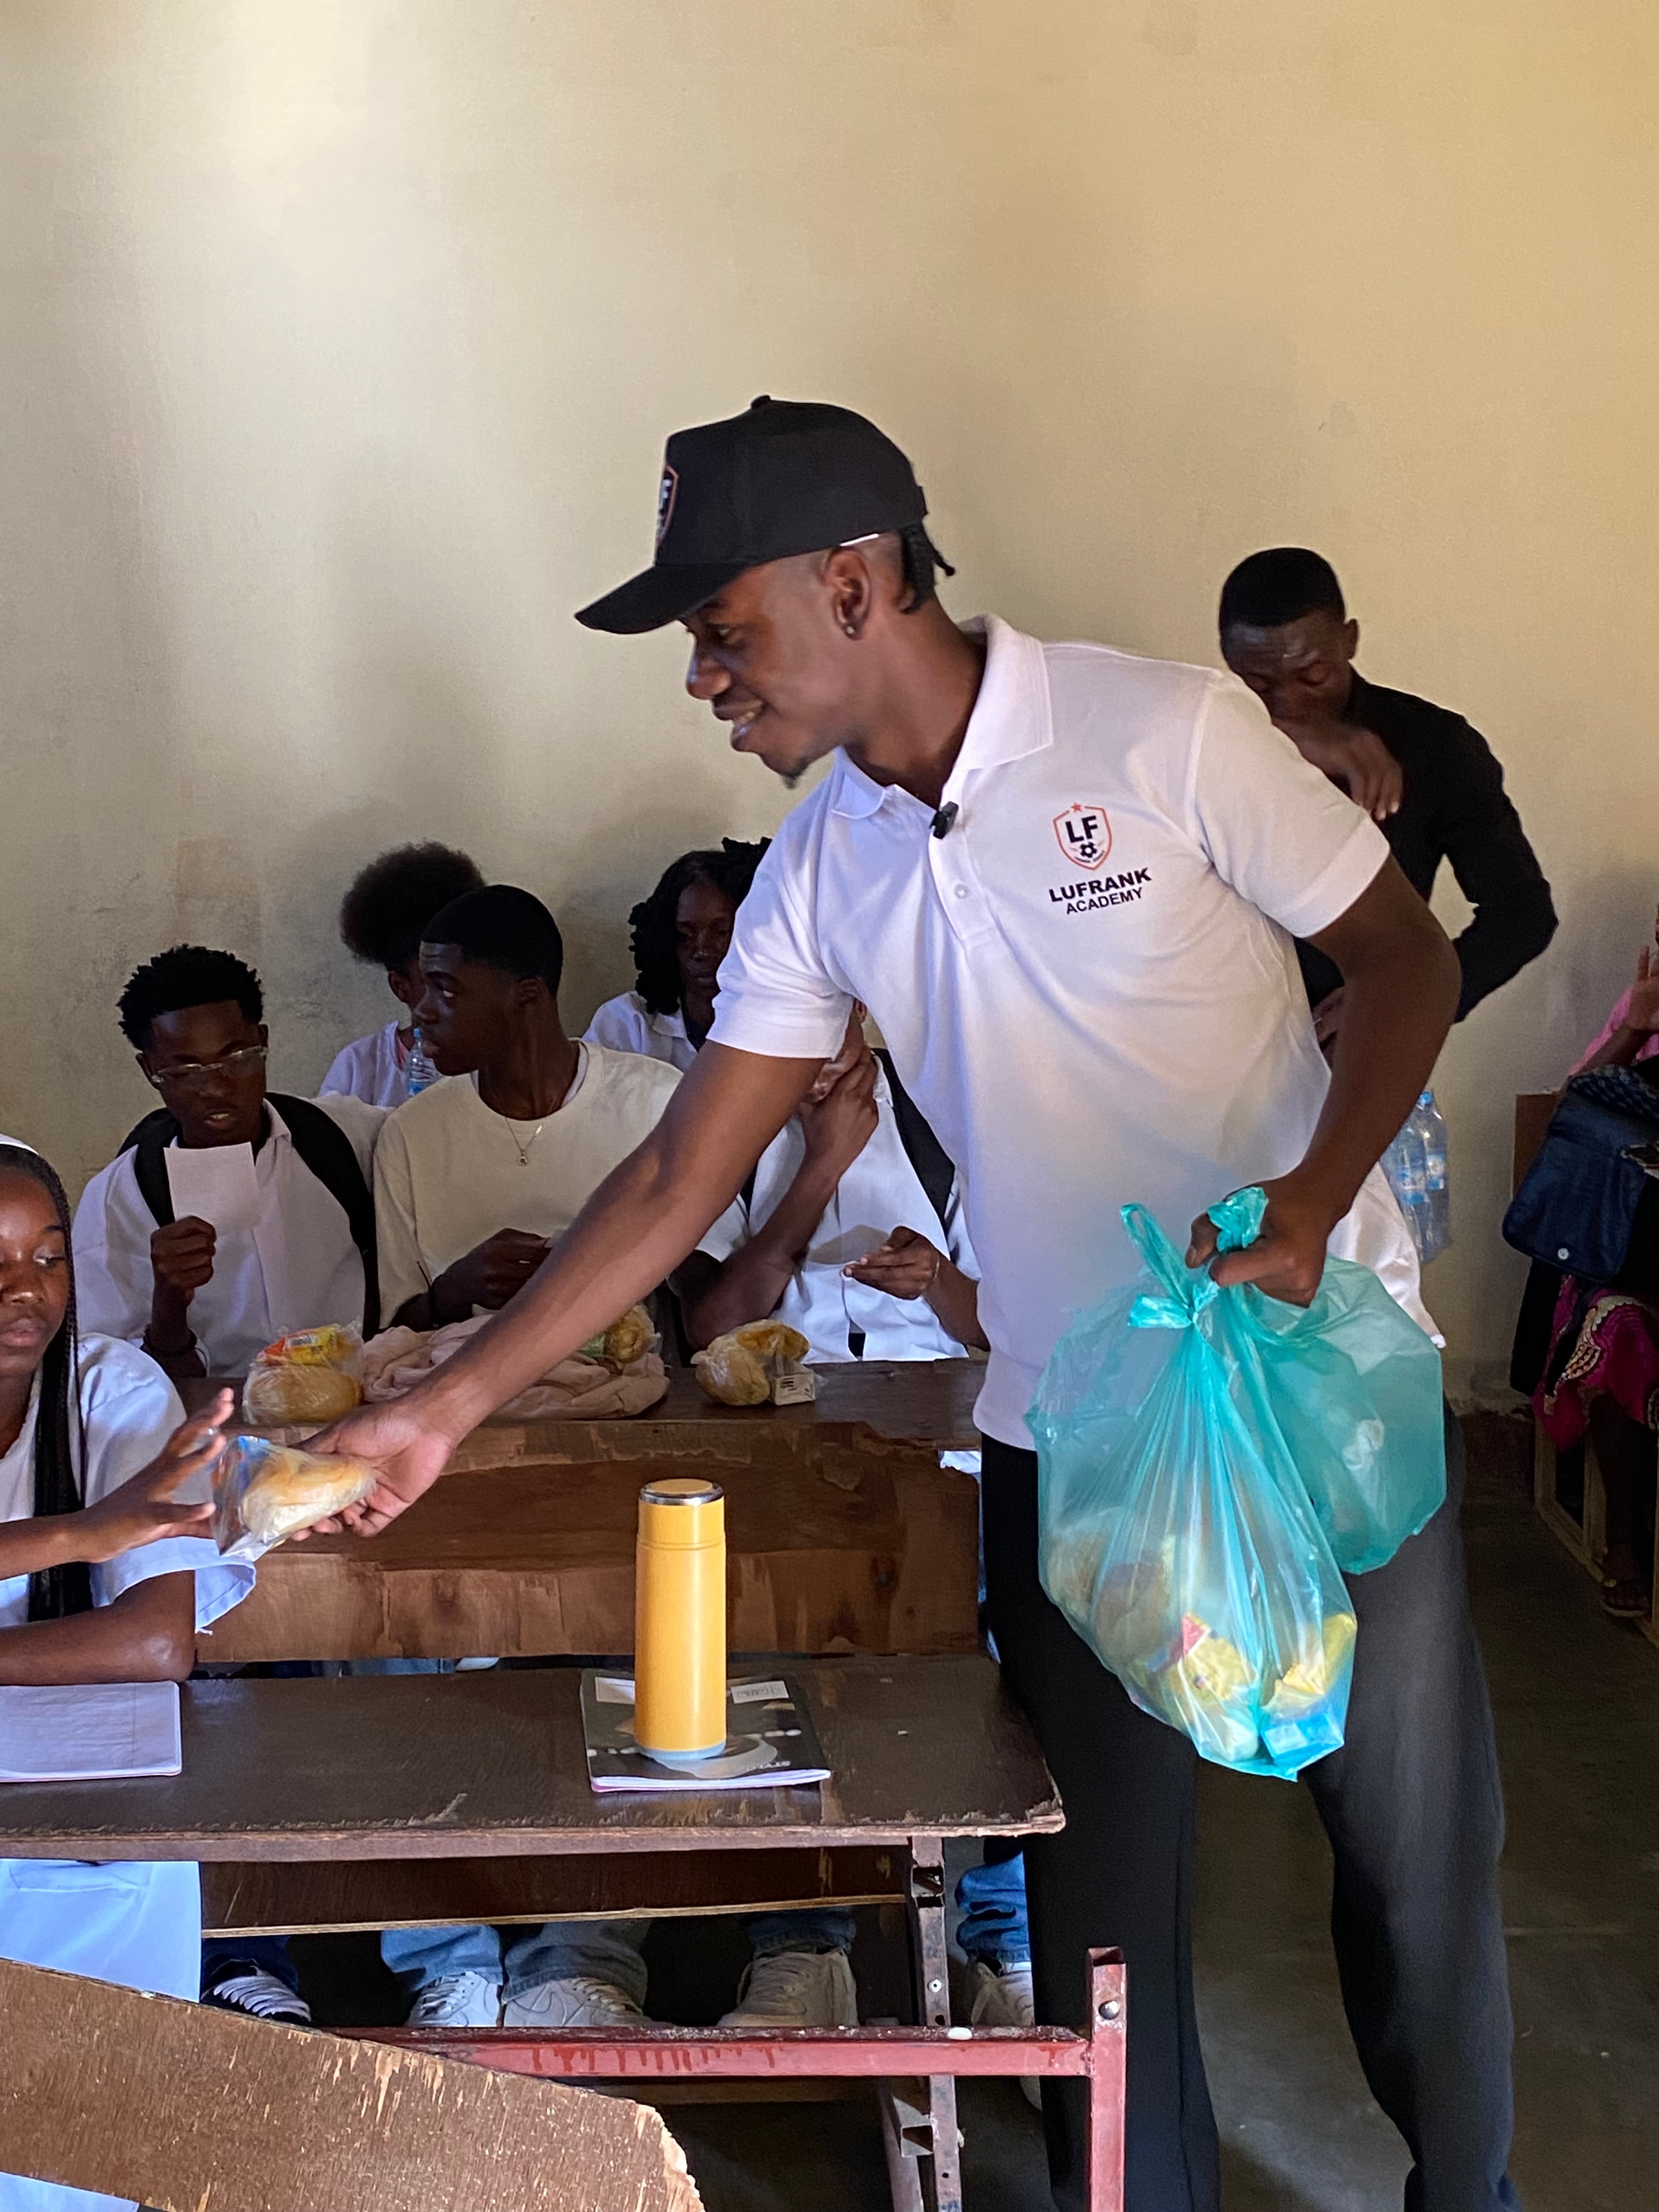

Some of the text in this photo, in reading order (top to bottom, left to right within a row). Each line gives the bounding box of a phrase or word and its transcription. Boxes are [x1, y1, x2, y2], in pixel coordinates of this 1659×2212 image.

[1066, 816, 1098, 843] LF
[1050, 868, 1152, 902] LUFRANK
[1067, 888, 1142, 914] ACADEMY
